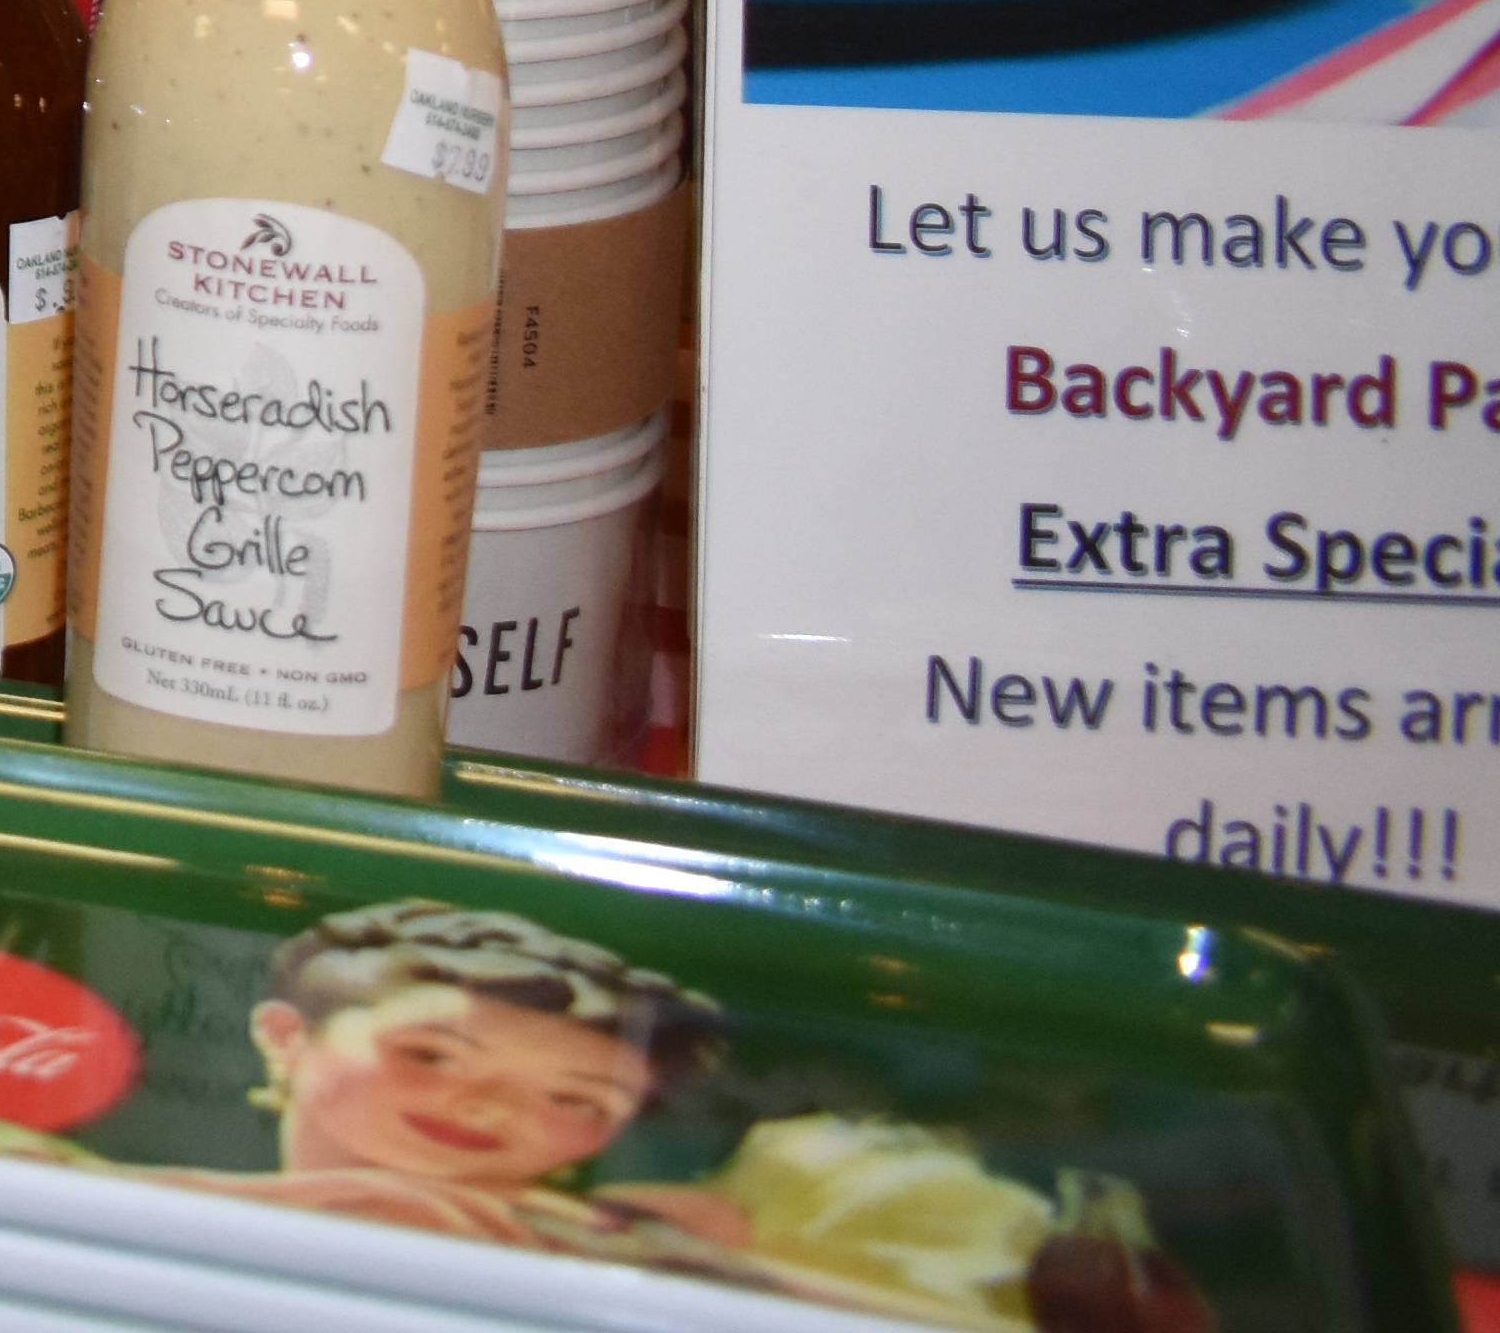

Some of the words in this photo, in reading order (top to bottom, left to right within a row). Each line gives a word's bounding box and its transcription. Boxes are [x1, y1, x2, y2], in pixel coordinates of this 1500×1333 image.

[167, 240, 378, 285] STONEWALL
[868, 183, 992, 260] Let
[1021, 204, 1111, 263] us
[1140, 193, 1367, 273] make
[154, 288, 219, 319] Creators
[225, 304, 243, 322] of
[248, 308, 324, 333] Specialty
[331, 315, 378, 332] Foods
[194, 273, 346, 311] KITCHEN
[129, 336, 391, 434] Horseradish
[1004, 345, 1398, 441] Backyard
[187, 505, 309, 577] Grille
[1016, 501, 1234, 579] Extra
[153, 568, 337, 642] Sauce
[924, 654, 1114, 729] New
[1141, 661, 1372, 741] items
[1164, 798, 1463, 885] daily!!!
